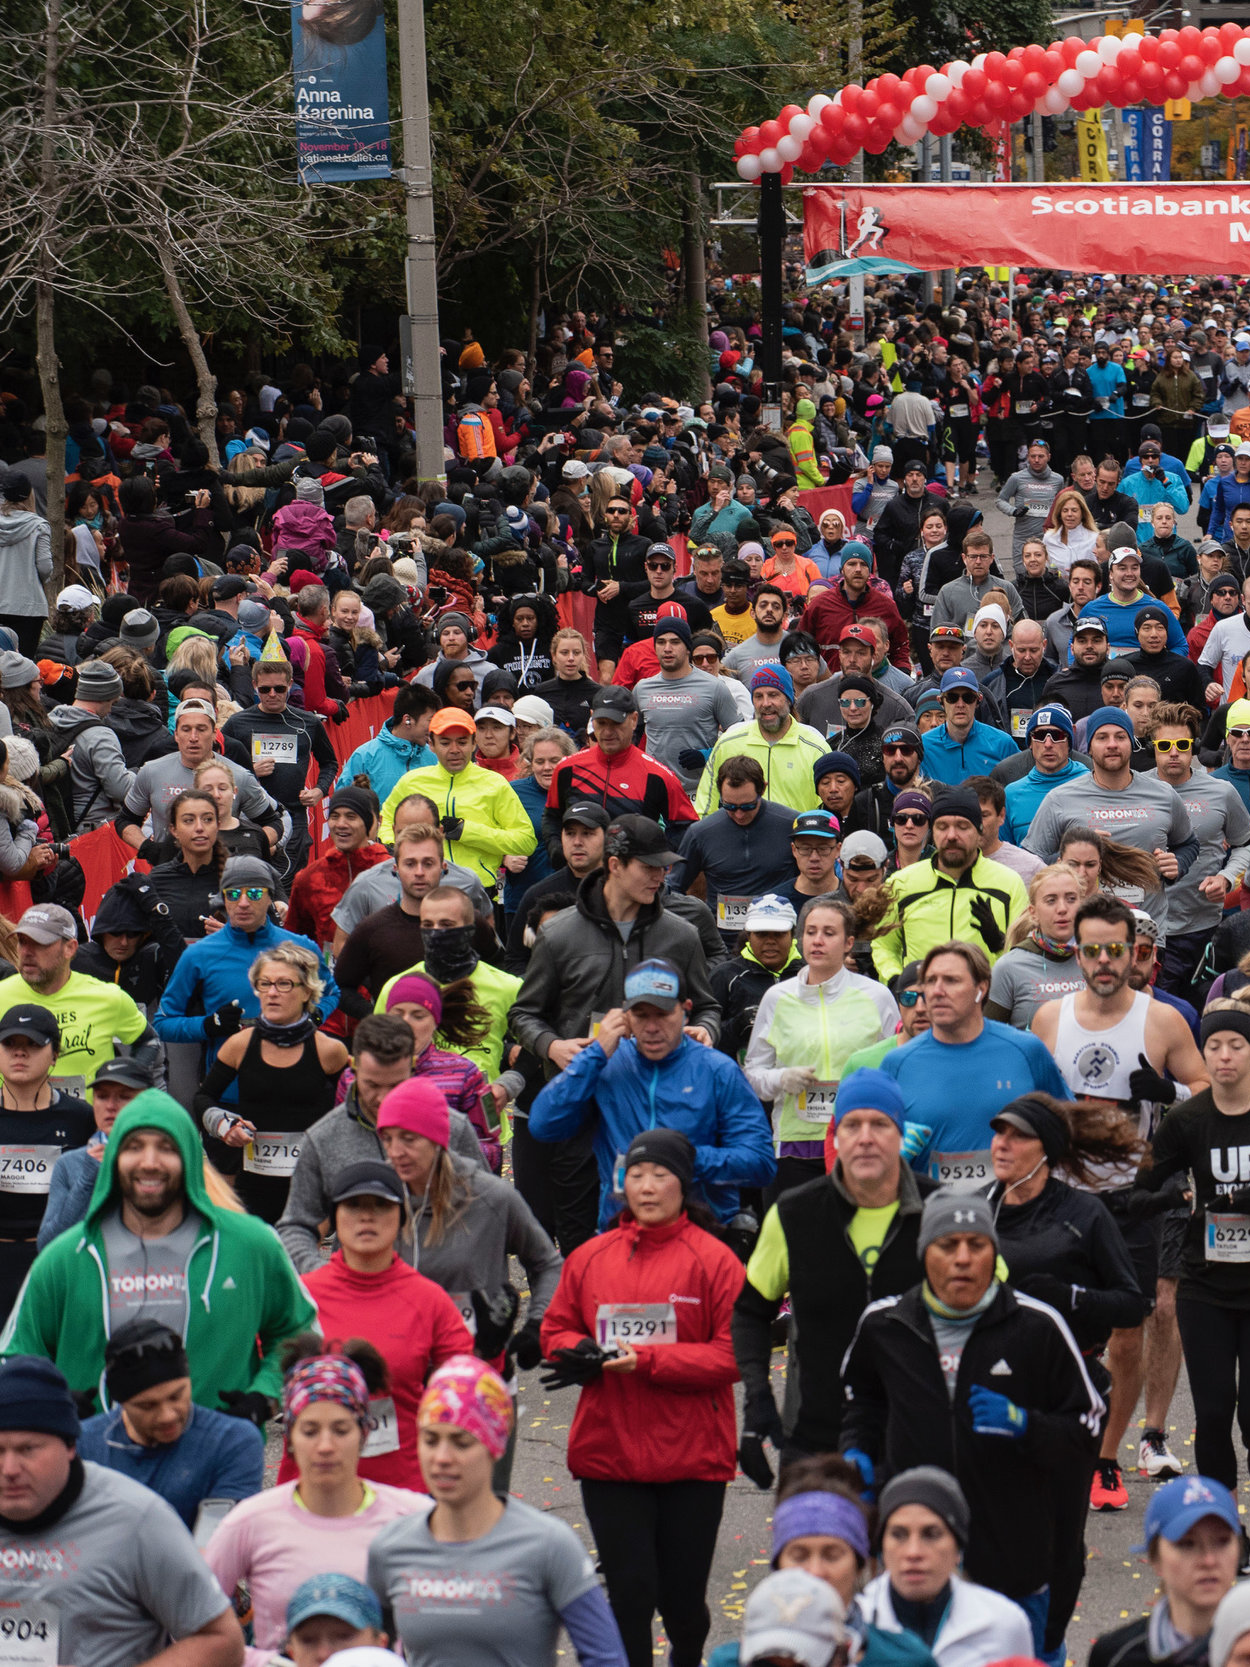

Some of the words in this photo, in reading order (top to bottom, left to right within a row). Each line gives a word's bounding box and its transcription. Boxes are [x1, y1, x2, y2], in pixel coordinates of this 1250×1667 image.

[297, 87, 341, 103] Anna
[298, 104, 375, 120] Karenina
[300, 142, 351, 151] November
[261, 741, 295, 752] 12789
[255, 1144, 301, 1158] 12716
[1, 1158, 48, 1173] 7406
[940, 1164, 987, 1180] 9523
[1215, 1228, 1248, 1243] 6229
[611, 1320, 668, 1337] 15291
